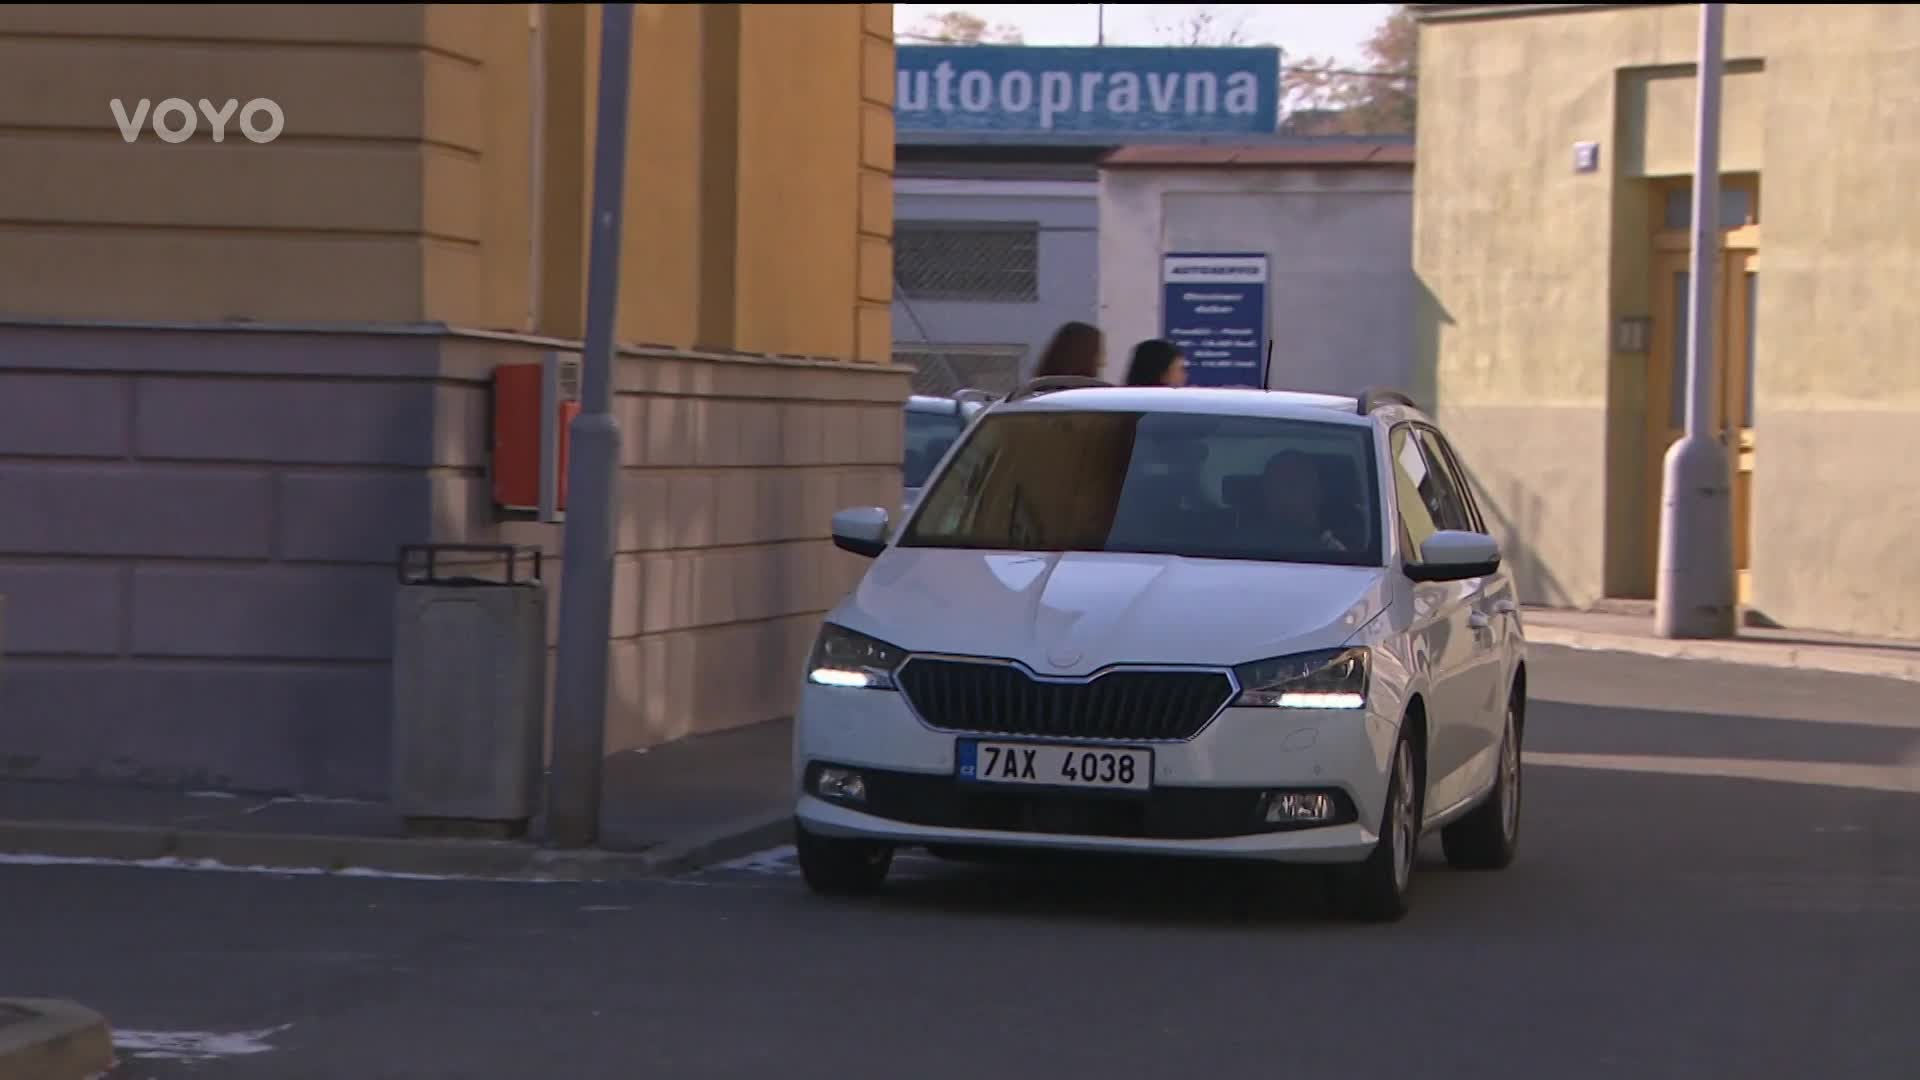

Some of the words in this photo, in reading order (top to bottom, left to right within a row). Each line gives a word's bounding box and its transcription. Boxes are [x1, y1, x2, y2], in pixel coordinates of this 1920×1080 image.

[897, 60, 1260, 129] utoopravna
[984, 747, 1036, 780] 7AX
[1061, 751, 1135, 784] 4038
